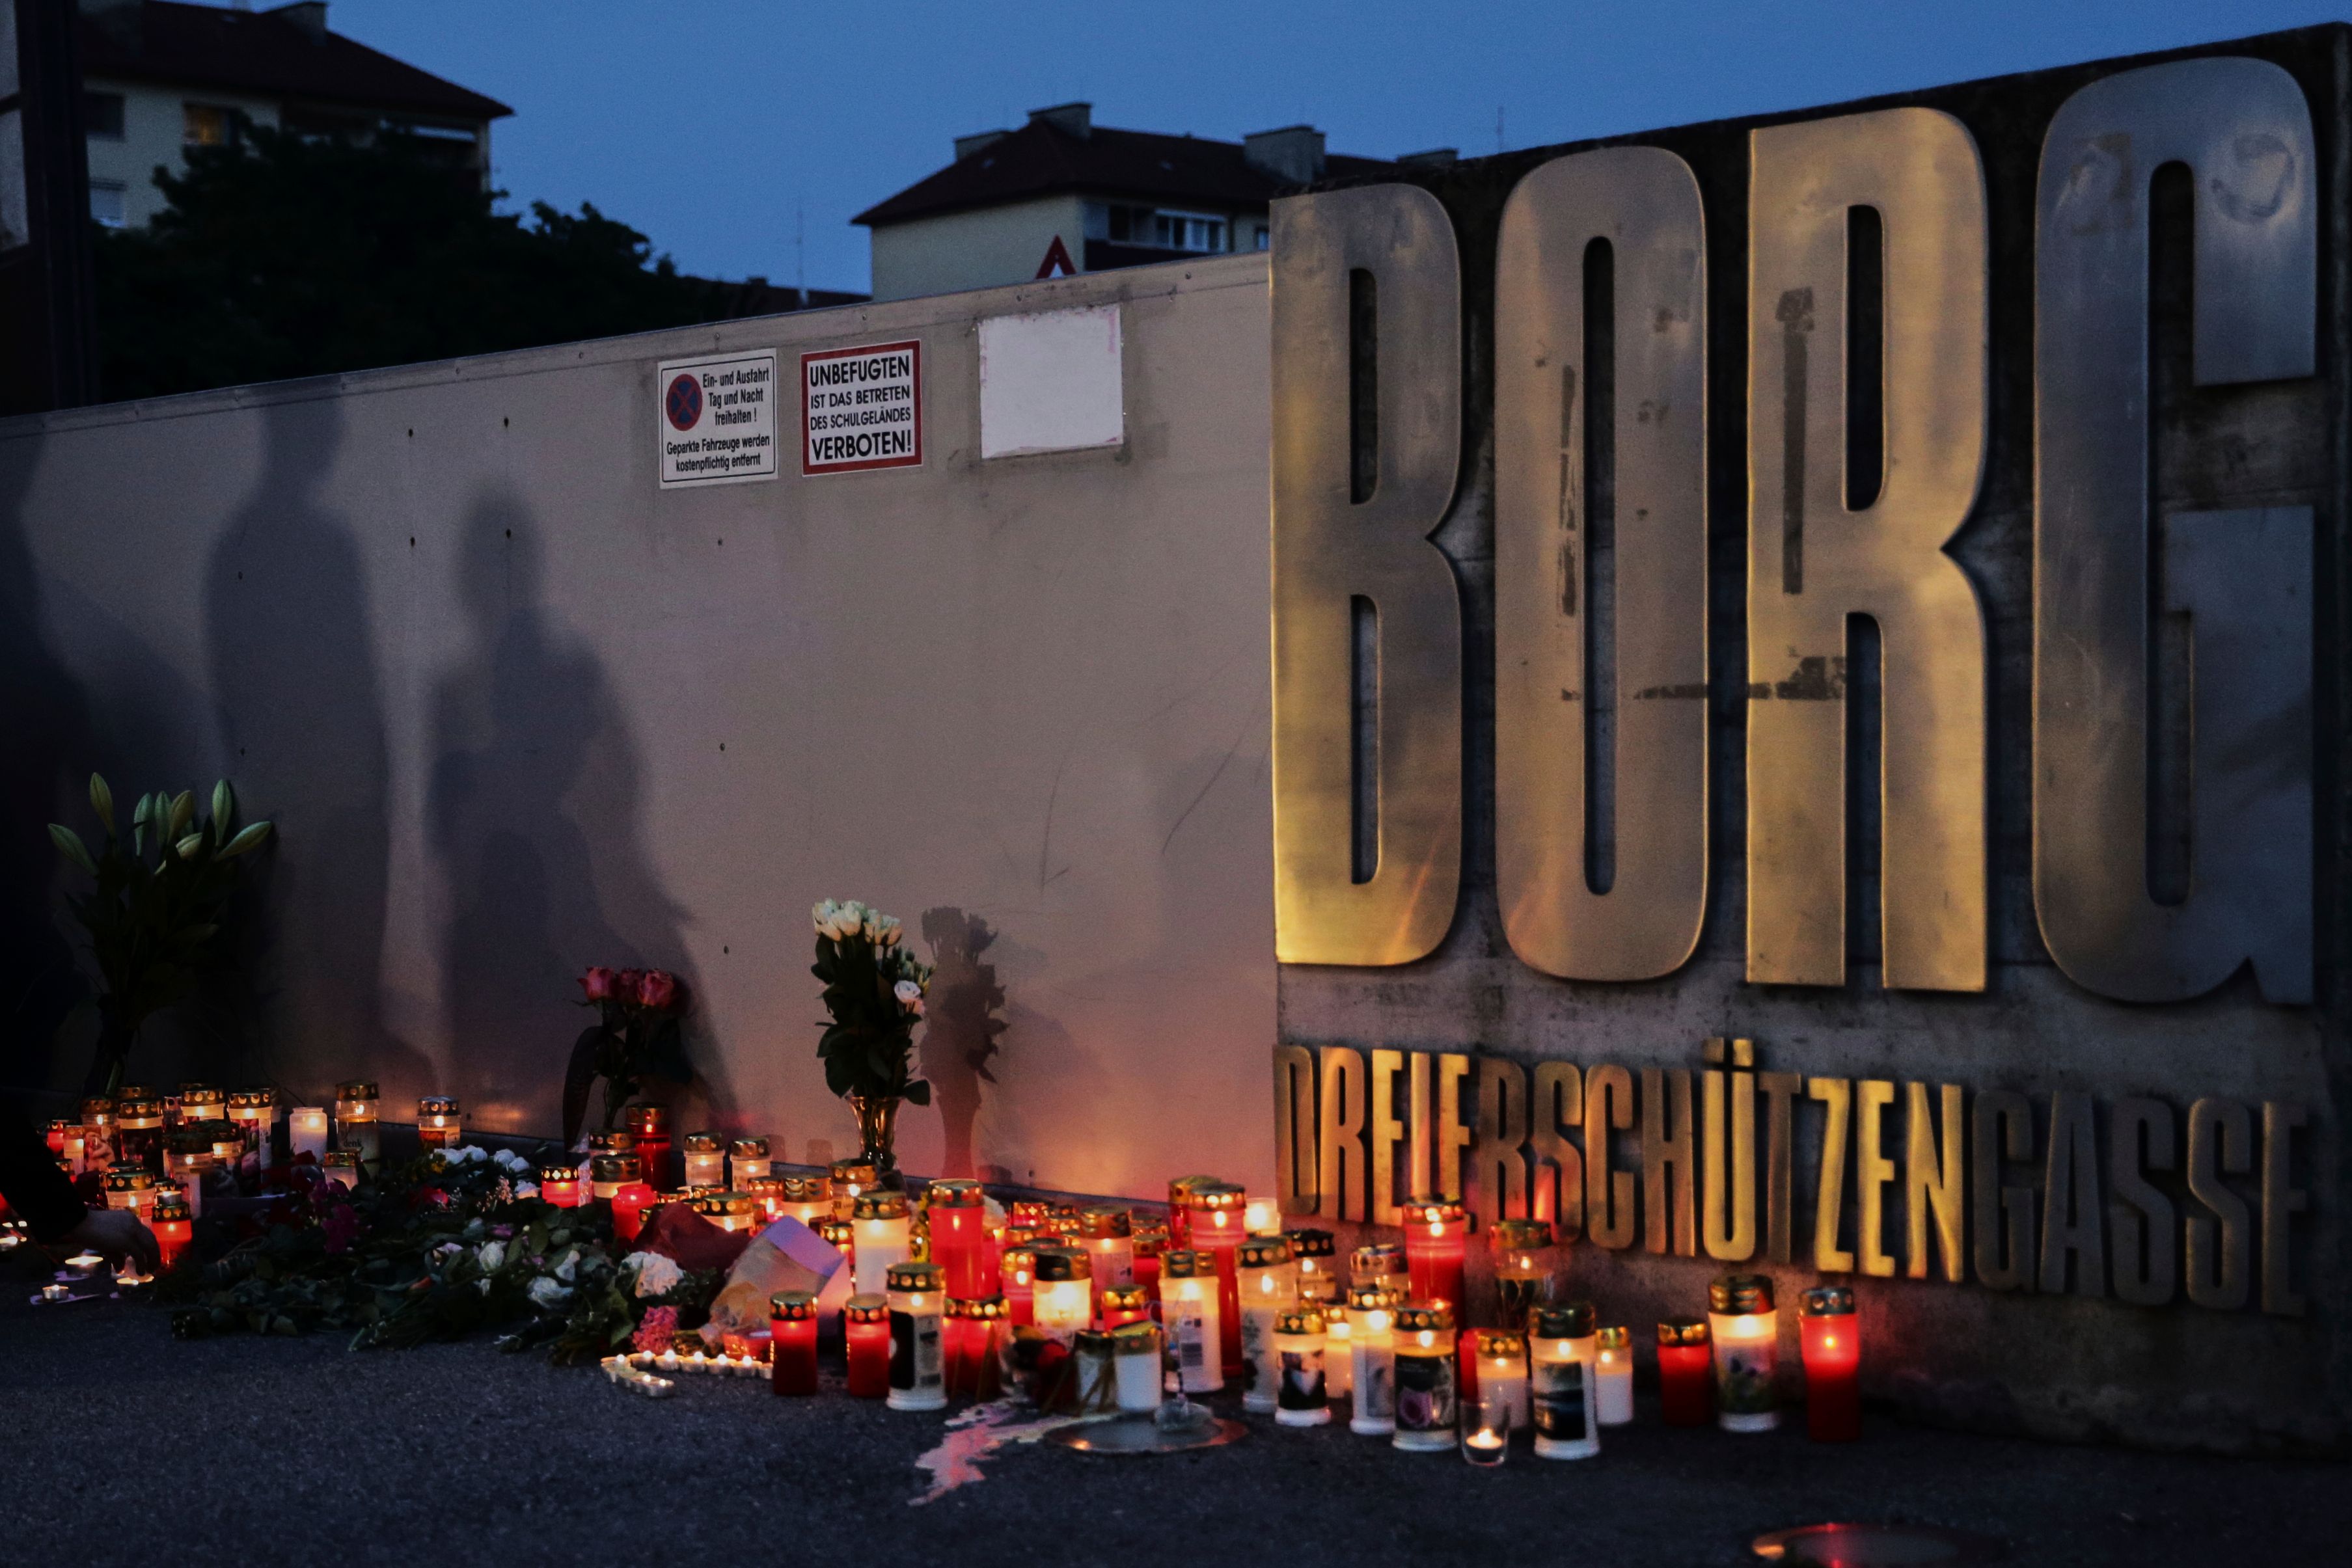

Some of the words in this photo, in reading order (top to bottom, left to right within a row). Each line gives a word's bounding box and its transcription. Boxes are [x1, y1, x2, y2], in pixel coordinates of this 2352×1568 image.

[702, 373, 718, 388] Ein-
[720, 371, 734, 386] und
[736, 367, 770, 385] Ausfahrt
[810, 355, 910, 387] UNBEFUGTEN
[708, 392, 722, 409] Tag
[724, 391, 738, 406] und
[741, 388, 764, 403] Nacht
[810, 394, 825, 409] IST
[829, 391, 852, 407] DAS
[856, 385, 910, 405] BETRETEN
[715, 410, 752, 426] freihalten
[810, 415, 828, 431] DES
[830, 406, 911, 429] SCHULGELÄNDES
[666, 440, 700, 458] Geparkte
[702, 437, 740, 452] Fahrzeuge
[742, 433, 770, 448] werden
[812, 429, 912, 461] VERBOTEN!
[676, 455, 730, 474] kostenpflichtig
[732, 453, 761, 468] entfernt
[1269, 56, 2317, 1005] BORG
[1273, 1037, 2308, 1317] DREIERSCHÜTZENGASSE
